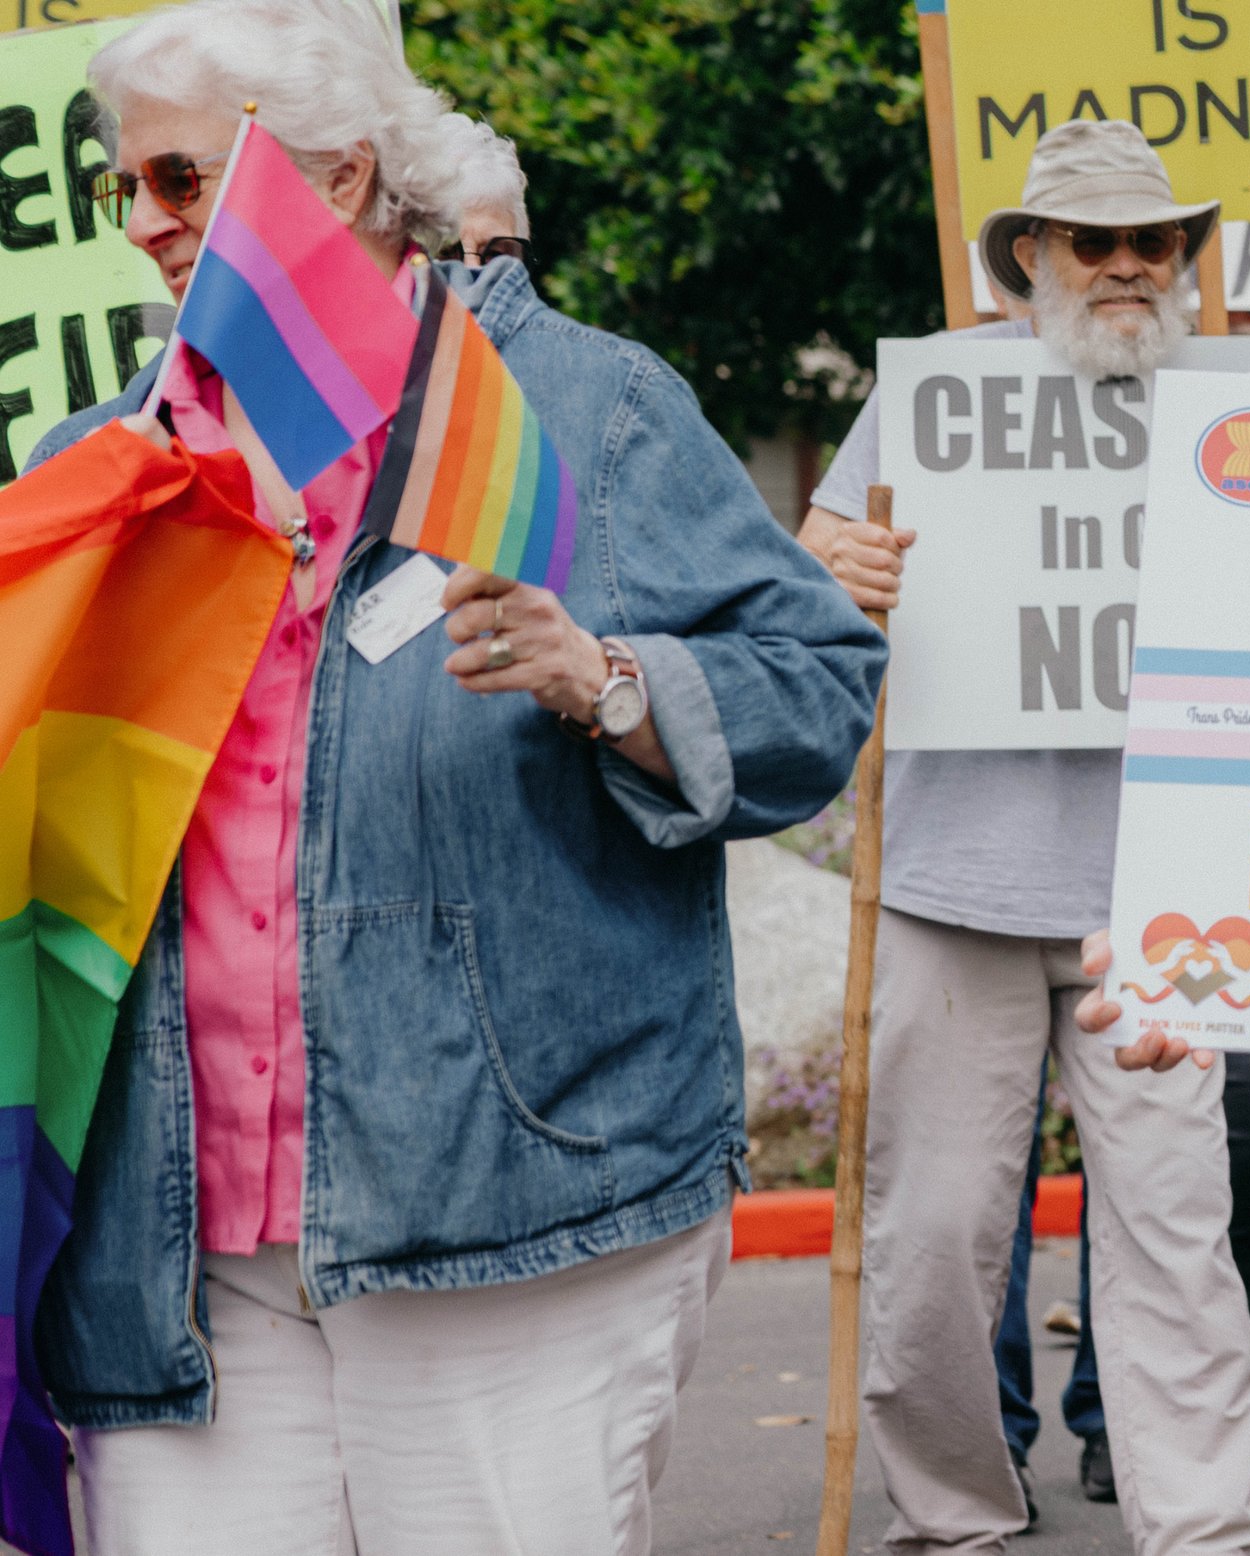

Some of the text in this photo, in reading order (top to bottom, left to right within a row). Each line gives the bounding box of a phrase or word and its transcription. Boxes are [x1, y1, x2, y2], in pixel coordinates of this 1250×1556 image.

[1154, 0, 1229, 52] IS
[1040, 505, 1103, 569] In
[1186, 705, 1221, 724] Trans
